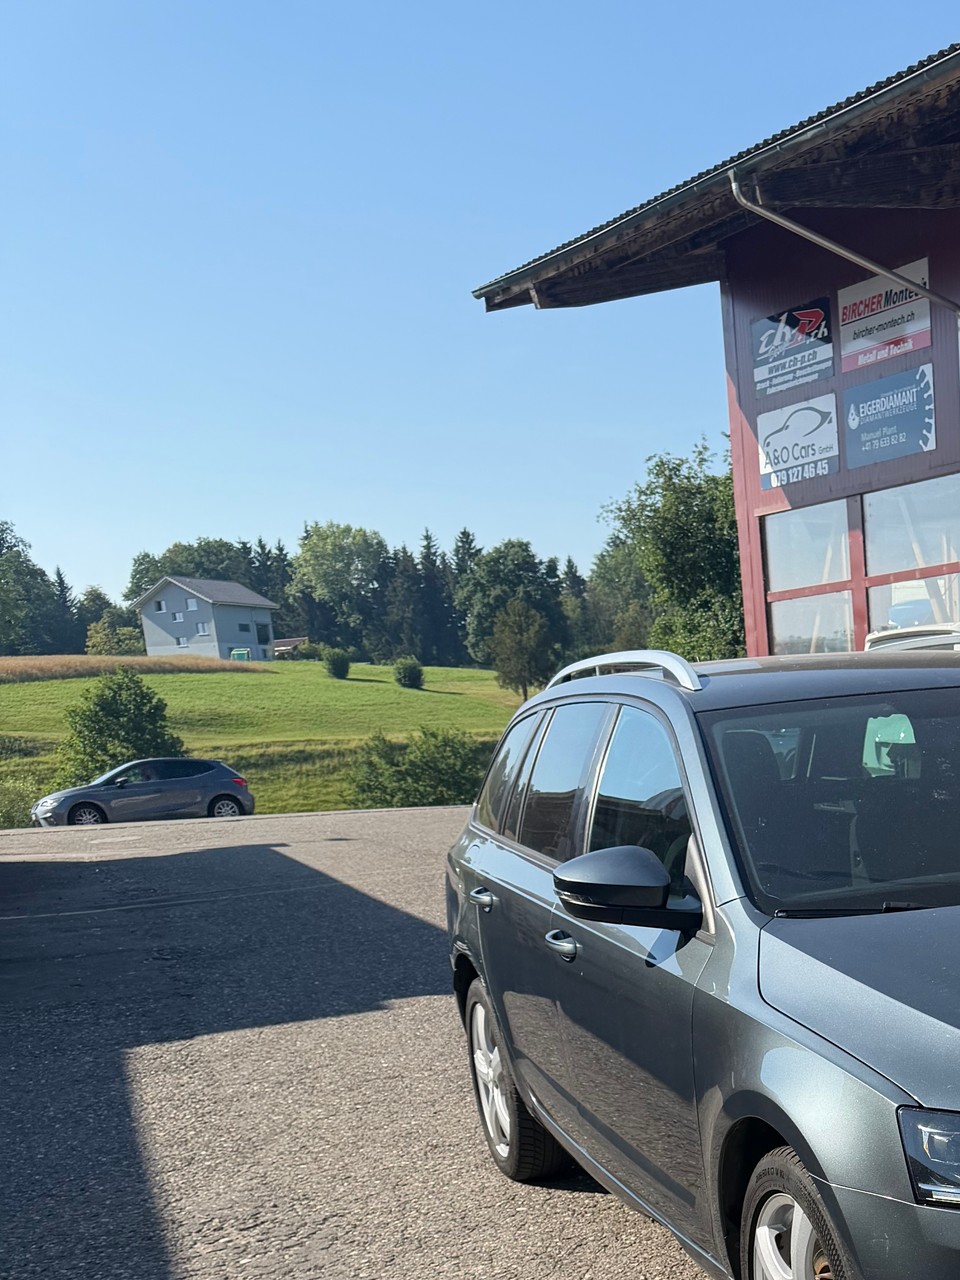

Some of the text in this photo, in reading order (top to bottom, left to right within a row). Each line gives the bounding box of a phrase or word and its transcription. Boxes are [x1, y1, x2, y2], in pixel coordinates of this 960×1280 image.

[841, 293, 884, 323] BIRCHER
[853, 311, 915, 340] bircher-montech.ch
[859, 388, 918, 417] EIGERDIAMANT
[764, 446, 790, 469] A&O
[792, 443, 817, 460] Cars
[770, 460, 829, 488] 079 127 46 45
